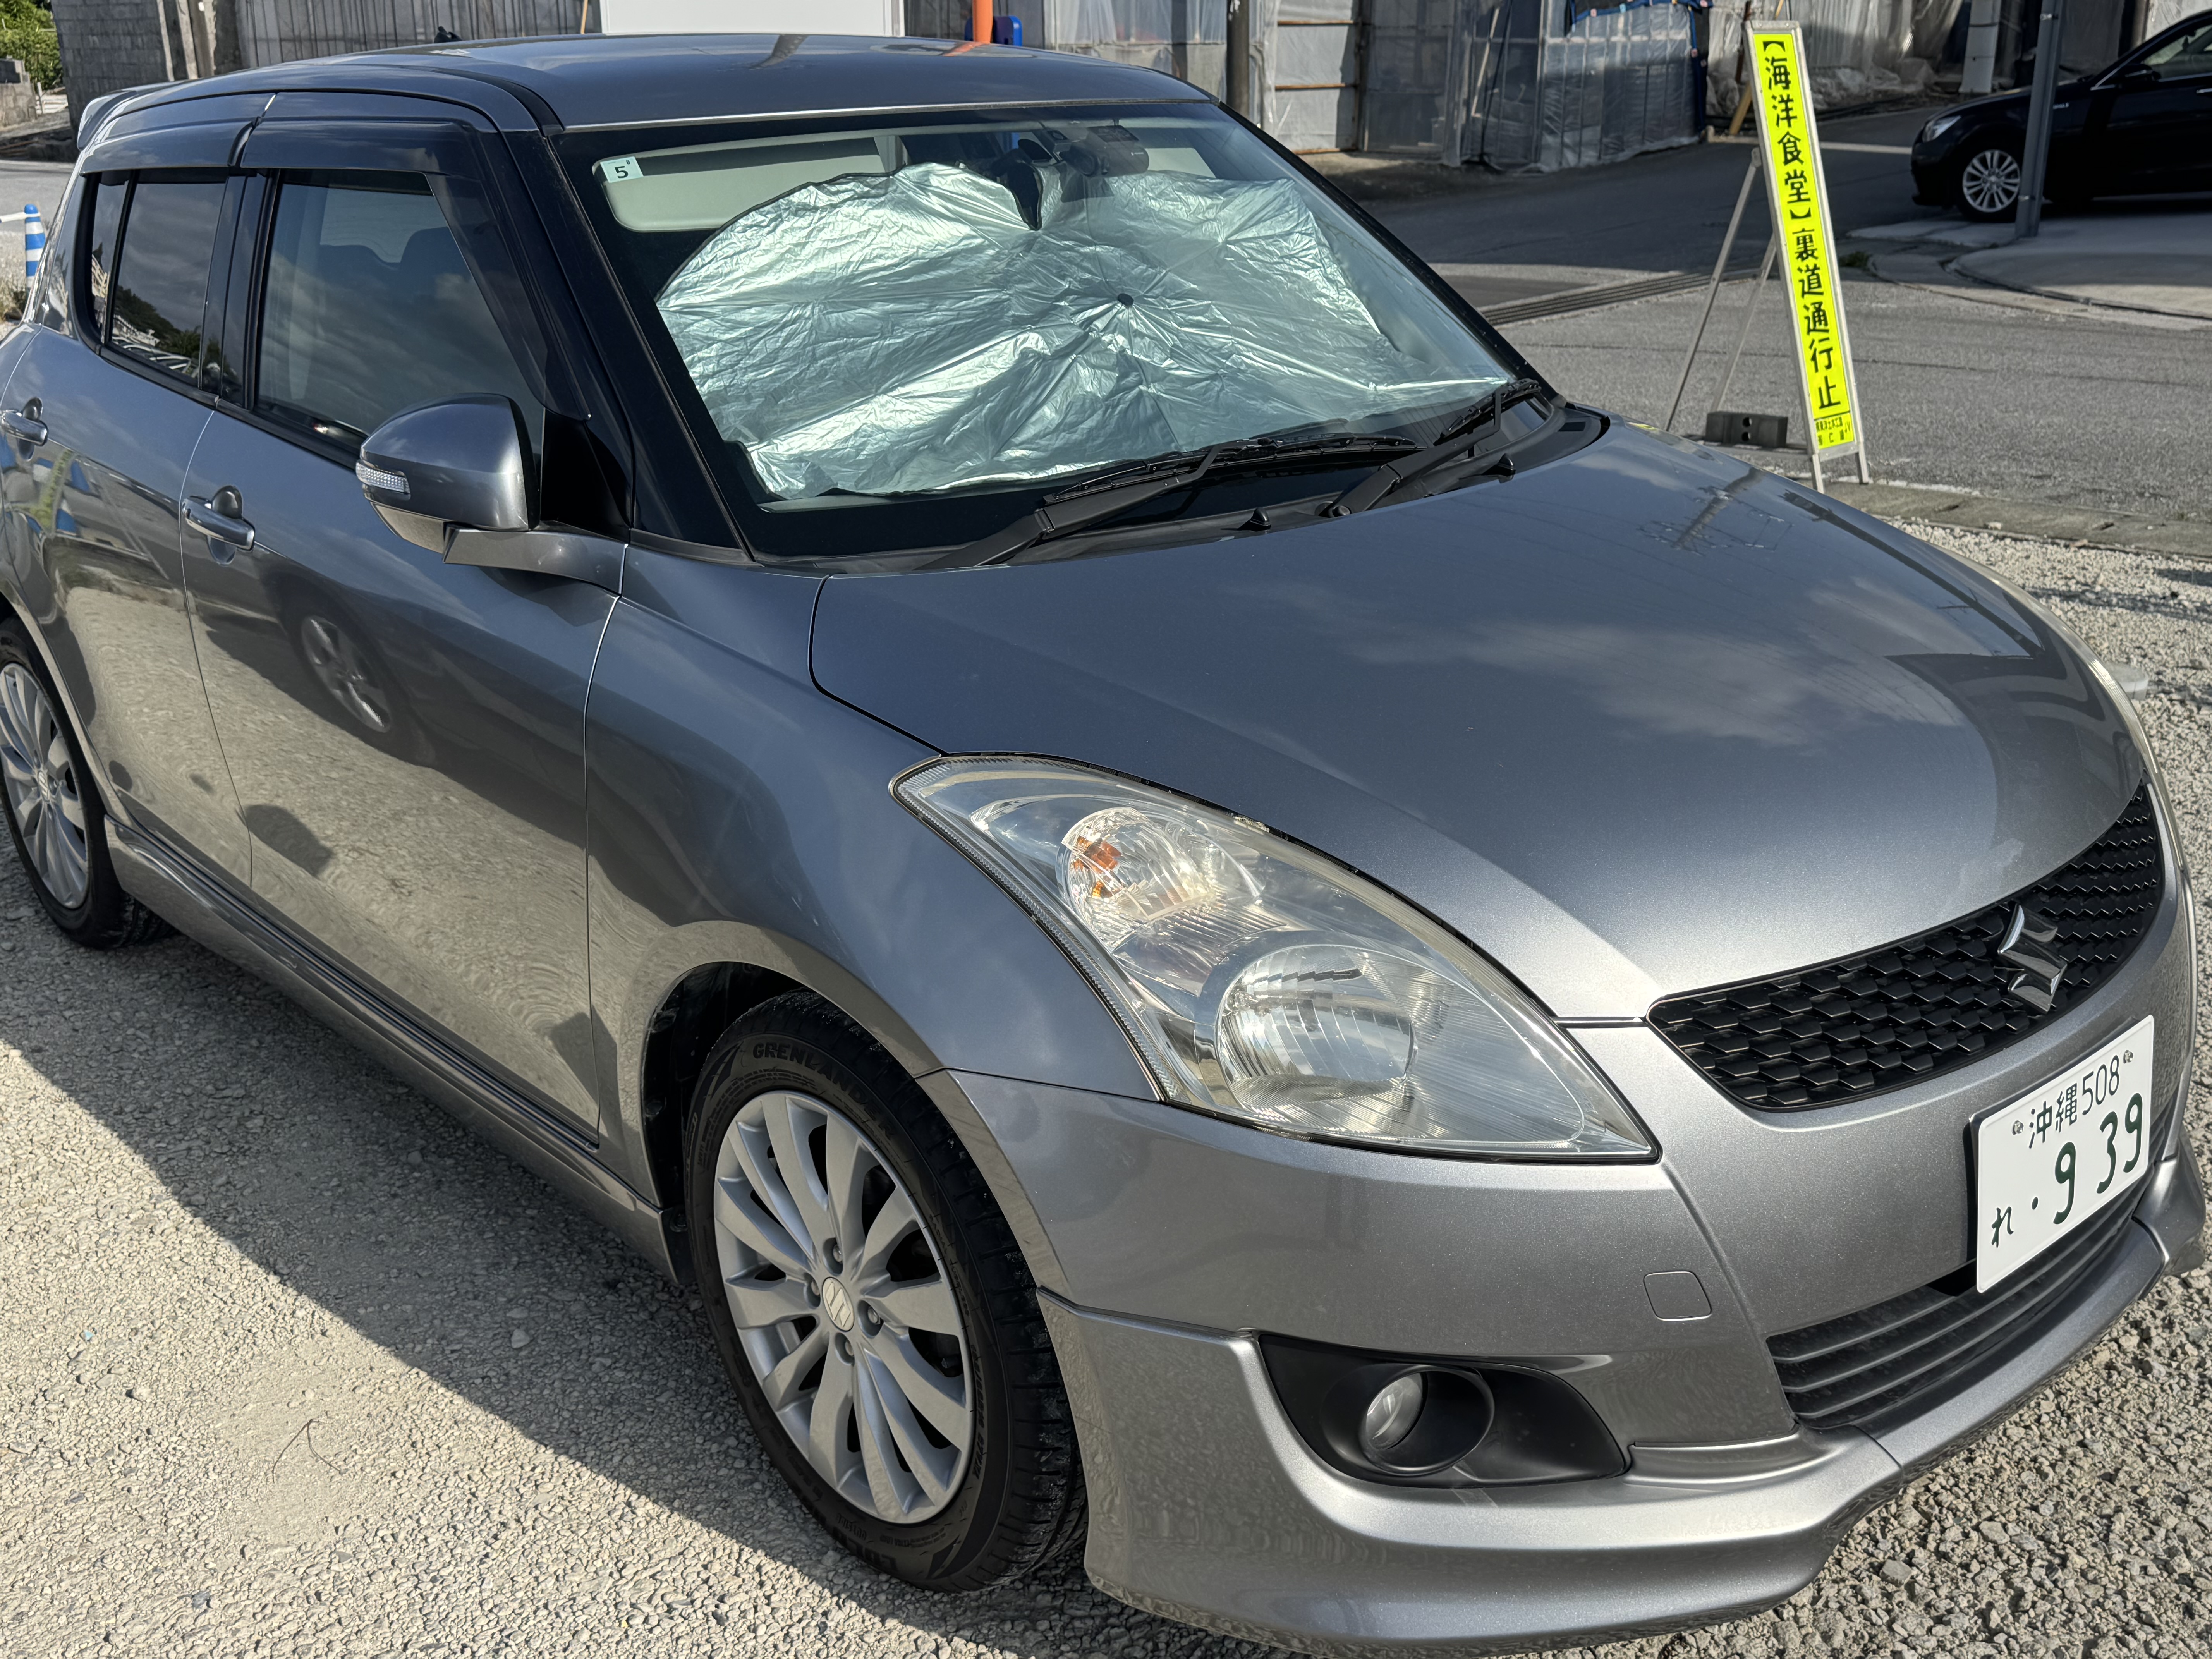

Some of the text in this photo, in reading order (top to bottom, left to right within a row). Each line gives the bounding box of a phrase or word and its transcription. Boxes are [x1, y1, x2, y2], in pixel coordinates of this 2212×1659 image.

[615, 166, 628, 178] 5
[753, 1042, 899, 1141] GRENLANDER
[1991, 1206, 2014, 1248] れ
